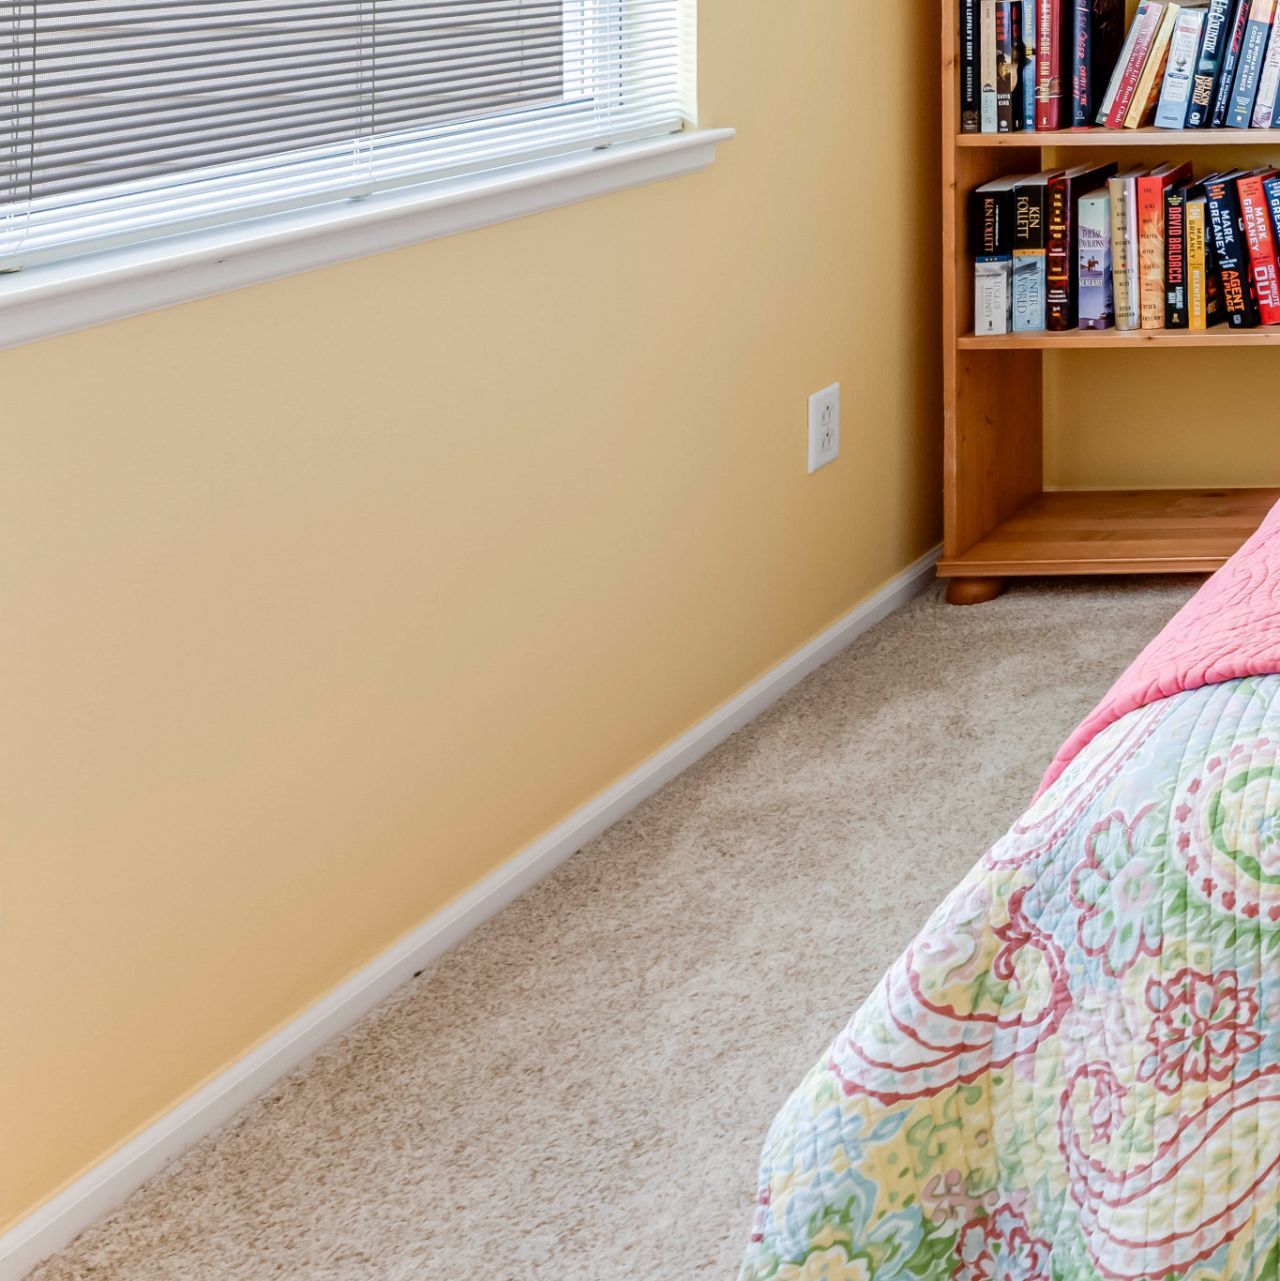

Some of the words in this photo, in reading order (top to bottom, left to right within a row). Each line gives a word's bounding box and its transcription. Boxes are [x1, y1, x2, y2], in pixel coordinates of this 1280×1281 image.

[985, 198, 994, 216] KEN
[1017, 196, 1029, 238] FOLLETT
[1029, 206, 1040, 229] KEN
[1168, 207, 1182, 236] DAVID
[1254, 207, 1268, 239] MARK
[1209, 201, 1226, 255] GREANEY
[1221, 210, 1234, 243] MARK
[1243, 198, 1260, 252] GREANEY
[1221, 271, 1228, 281] IN
[1228, 270, 1245, 310] AGENT
[1254, 266, 1273, 308] OUT
[1224, 282, 1235, 312] PLACE
